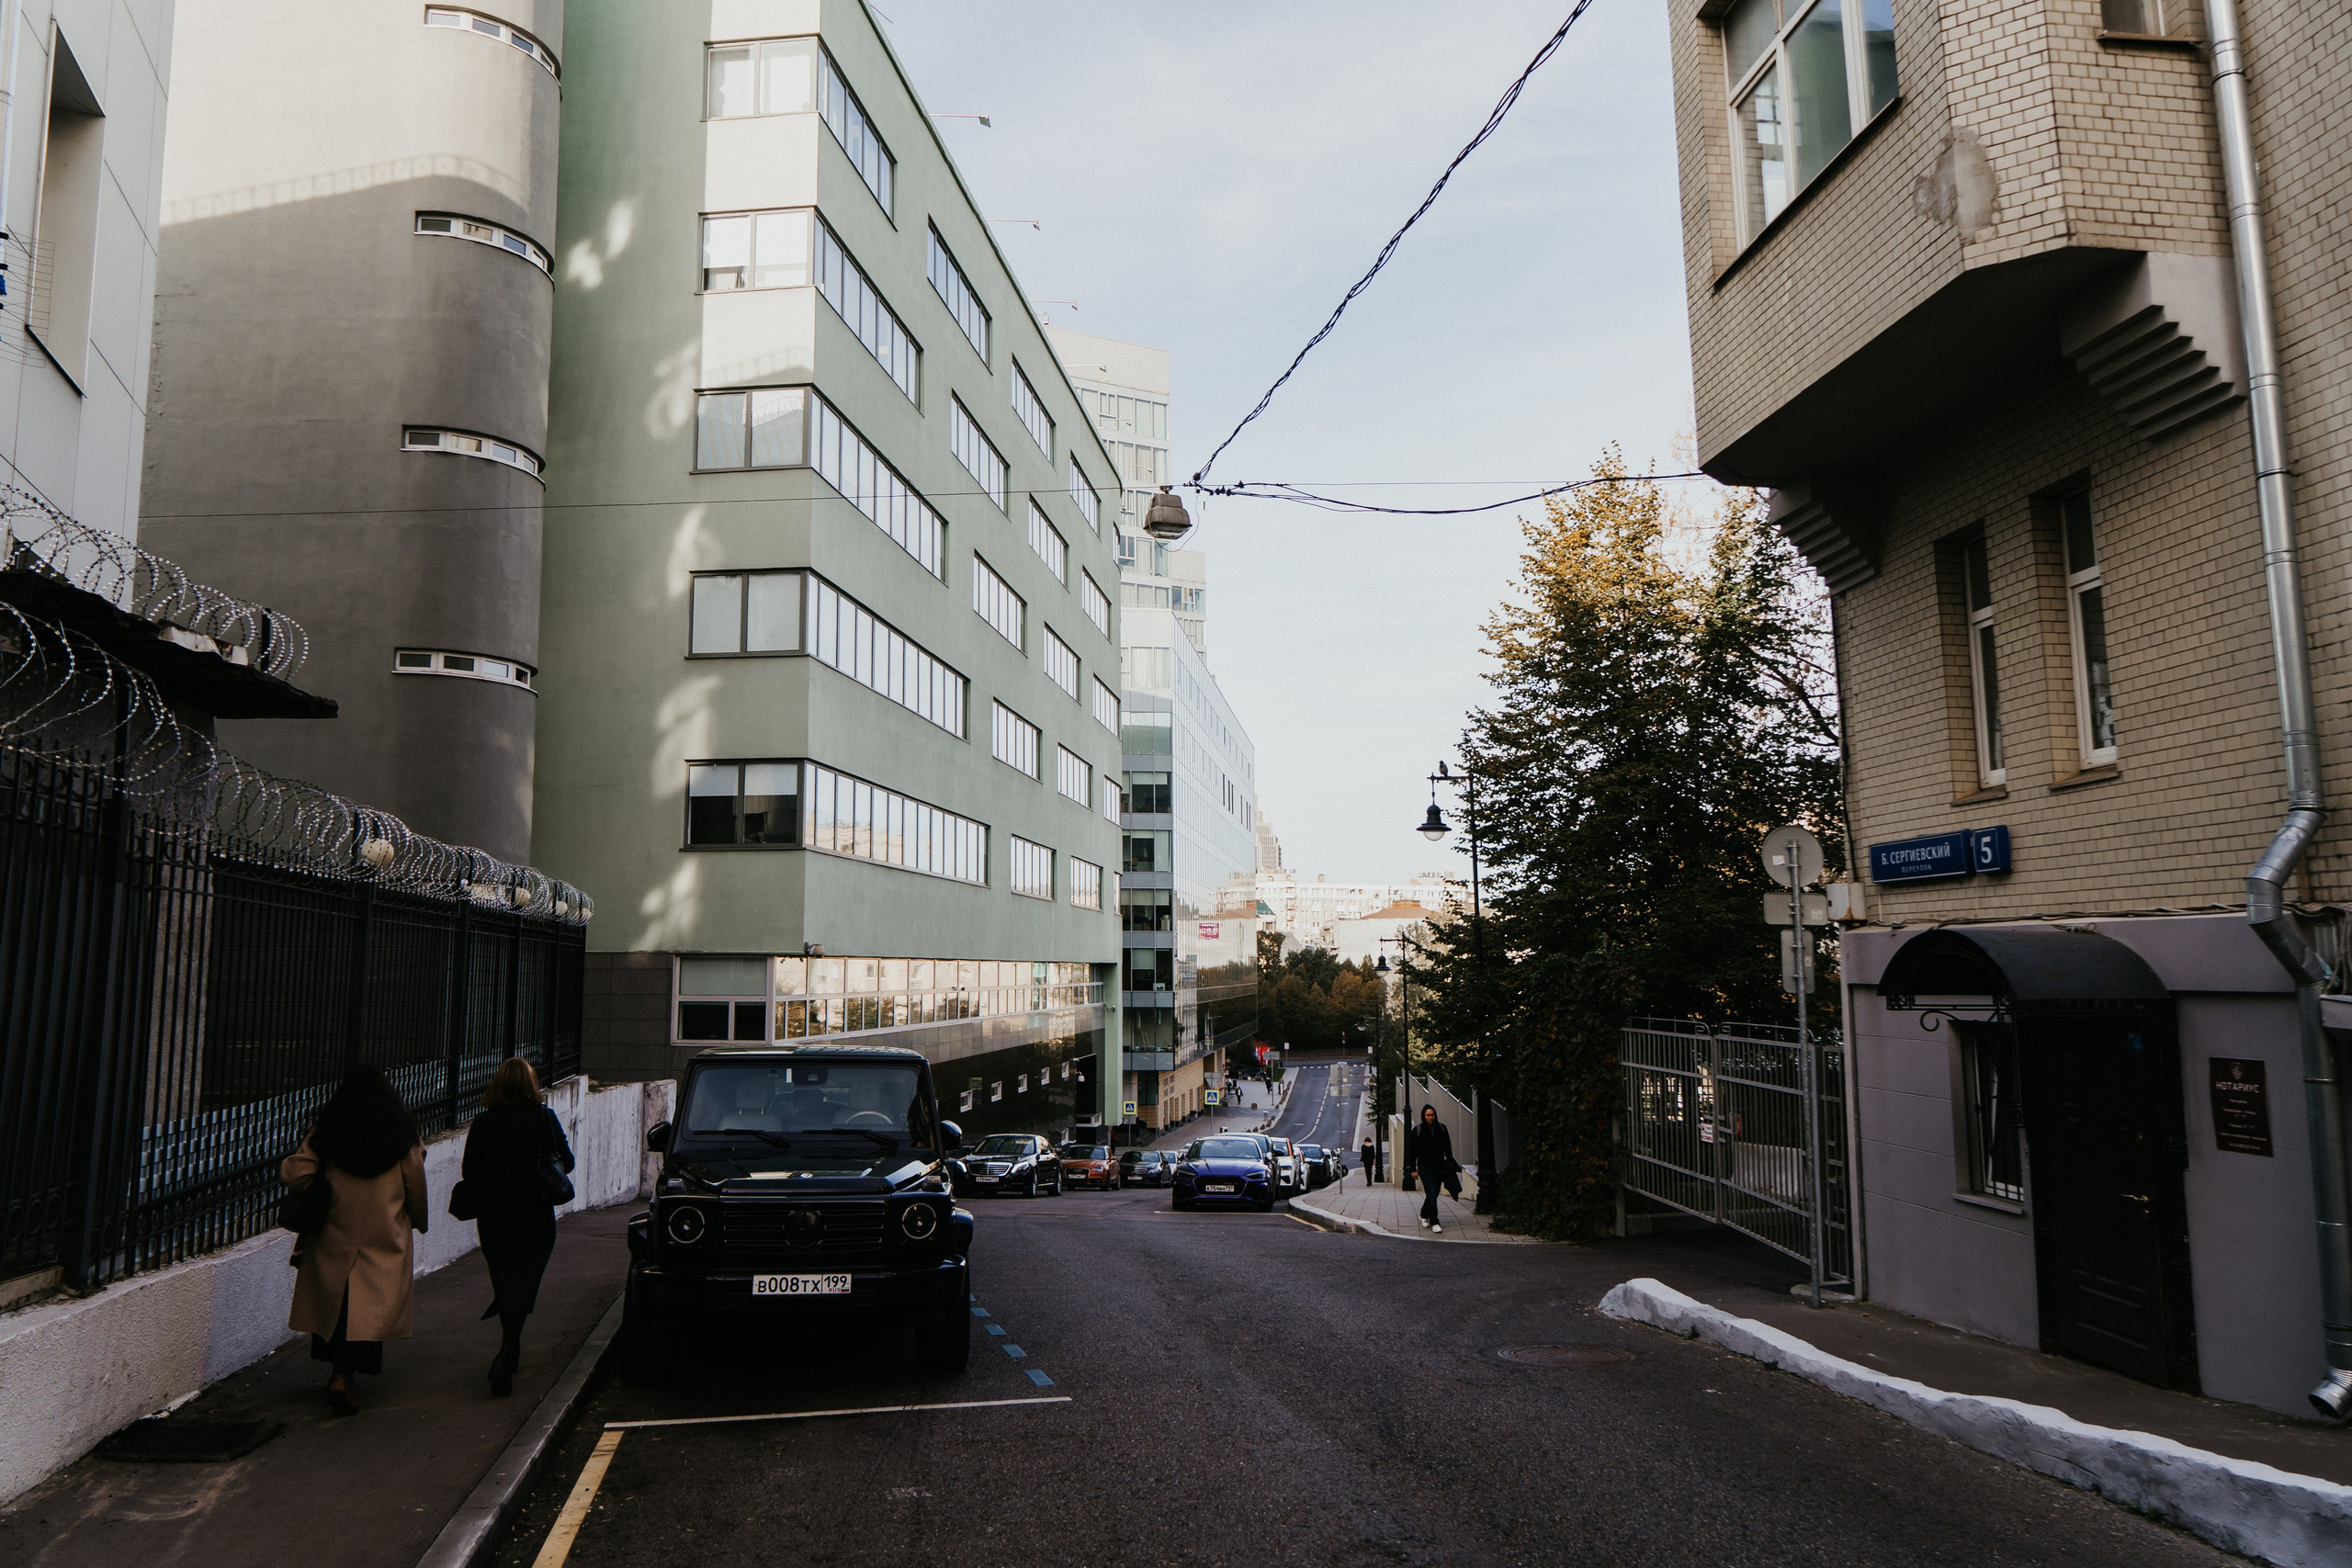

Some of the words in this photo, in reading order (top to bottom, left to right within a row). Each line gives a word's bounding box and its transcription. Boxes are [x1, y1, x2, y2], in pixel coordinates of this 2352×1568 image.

[1882, 852, 1889, 864] Б.
[1890, 842, 1951, 864] СЕРГИЕВСКИЙ
[1981, 836, 1992, 863] 5
[1901, 864, 1932, 874] ПЕРЕУЛОК
[2215, 1081, 2260, 1093] НОТАРИУС
[824, 1276, 848, 1288] 199
